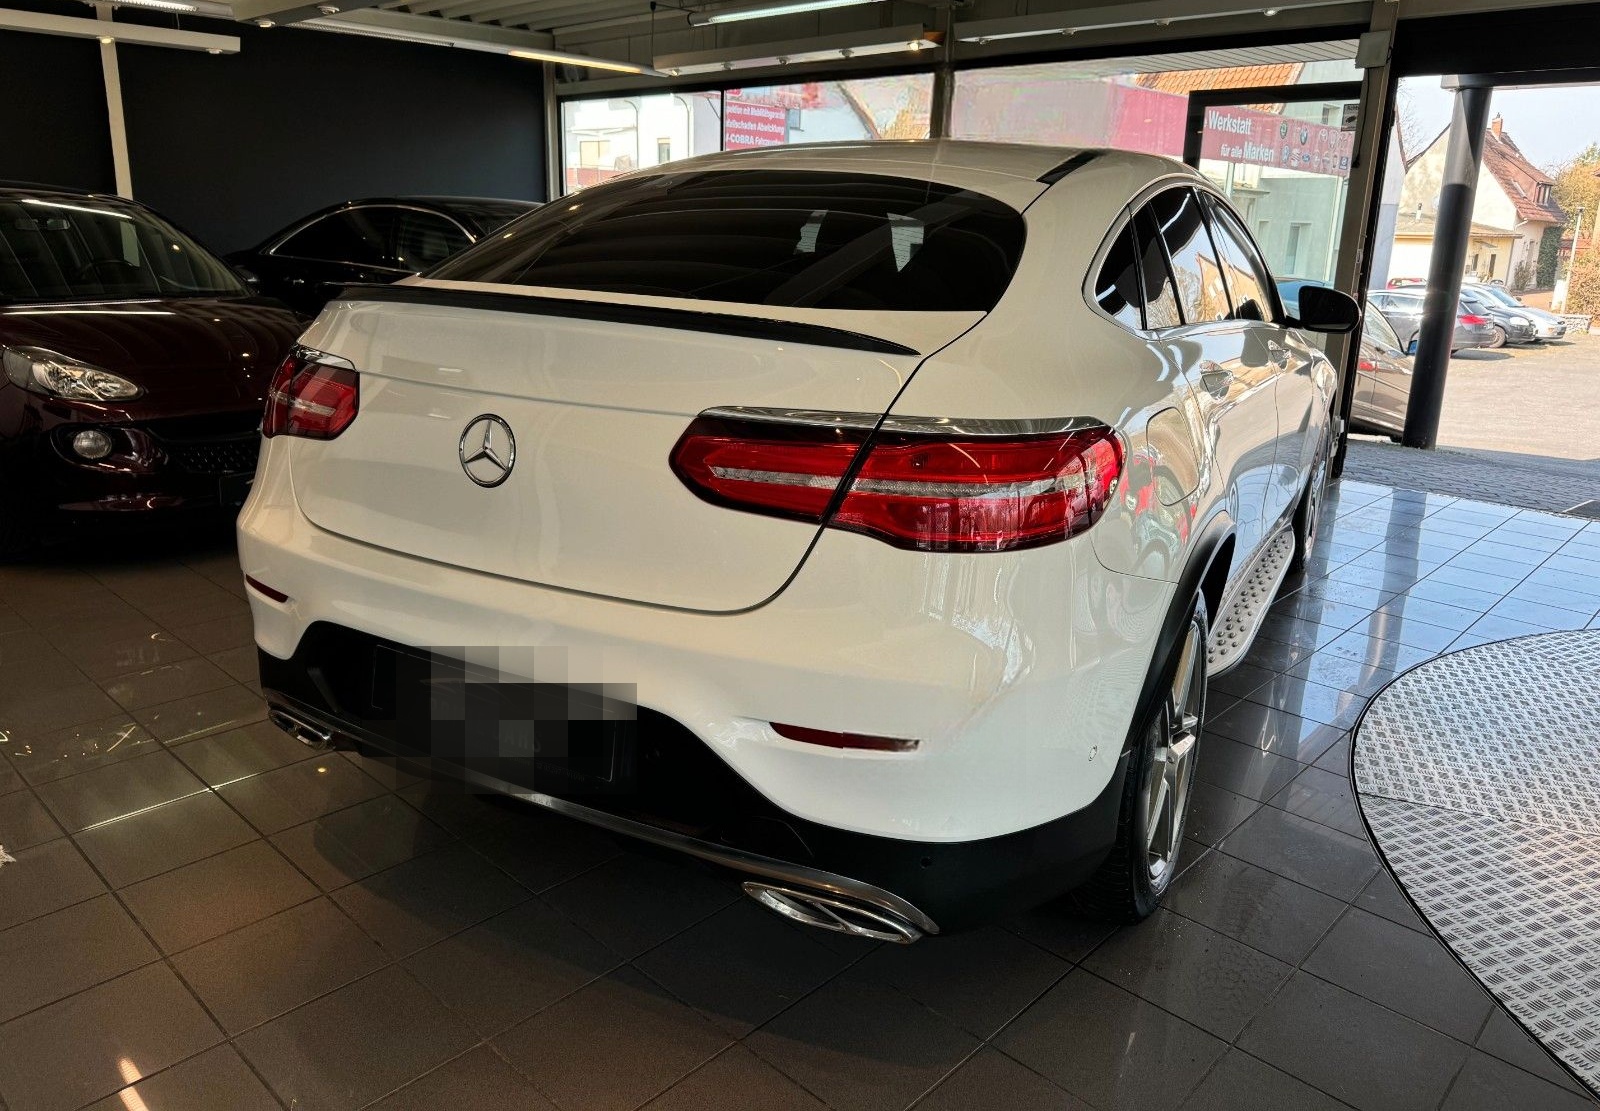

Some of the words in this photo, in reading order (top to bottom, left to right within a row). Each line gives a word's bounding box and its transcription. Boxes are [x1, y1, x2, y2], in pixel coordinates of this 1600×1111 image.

[758, 122, 785, 135] Abwicklung
[1208, 110, 1252, 135] Werkstatt
[1220, 143, 1231, 157] für
[1231, 145, 1243, 158] alle
[1243, 140, 1274, 162] Marken
